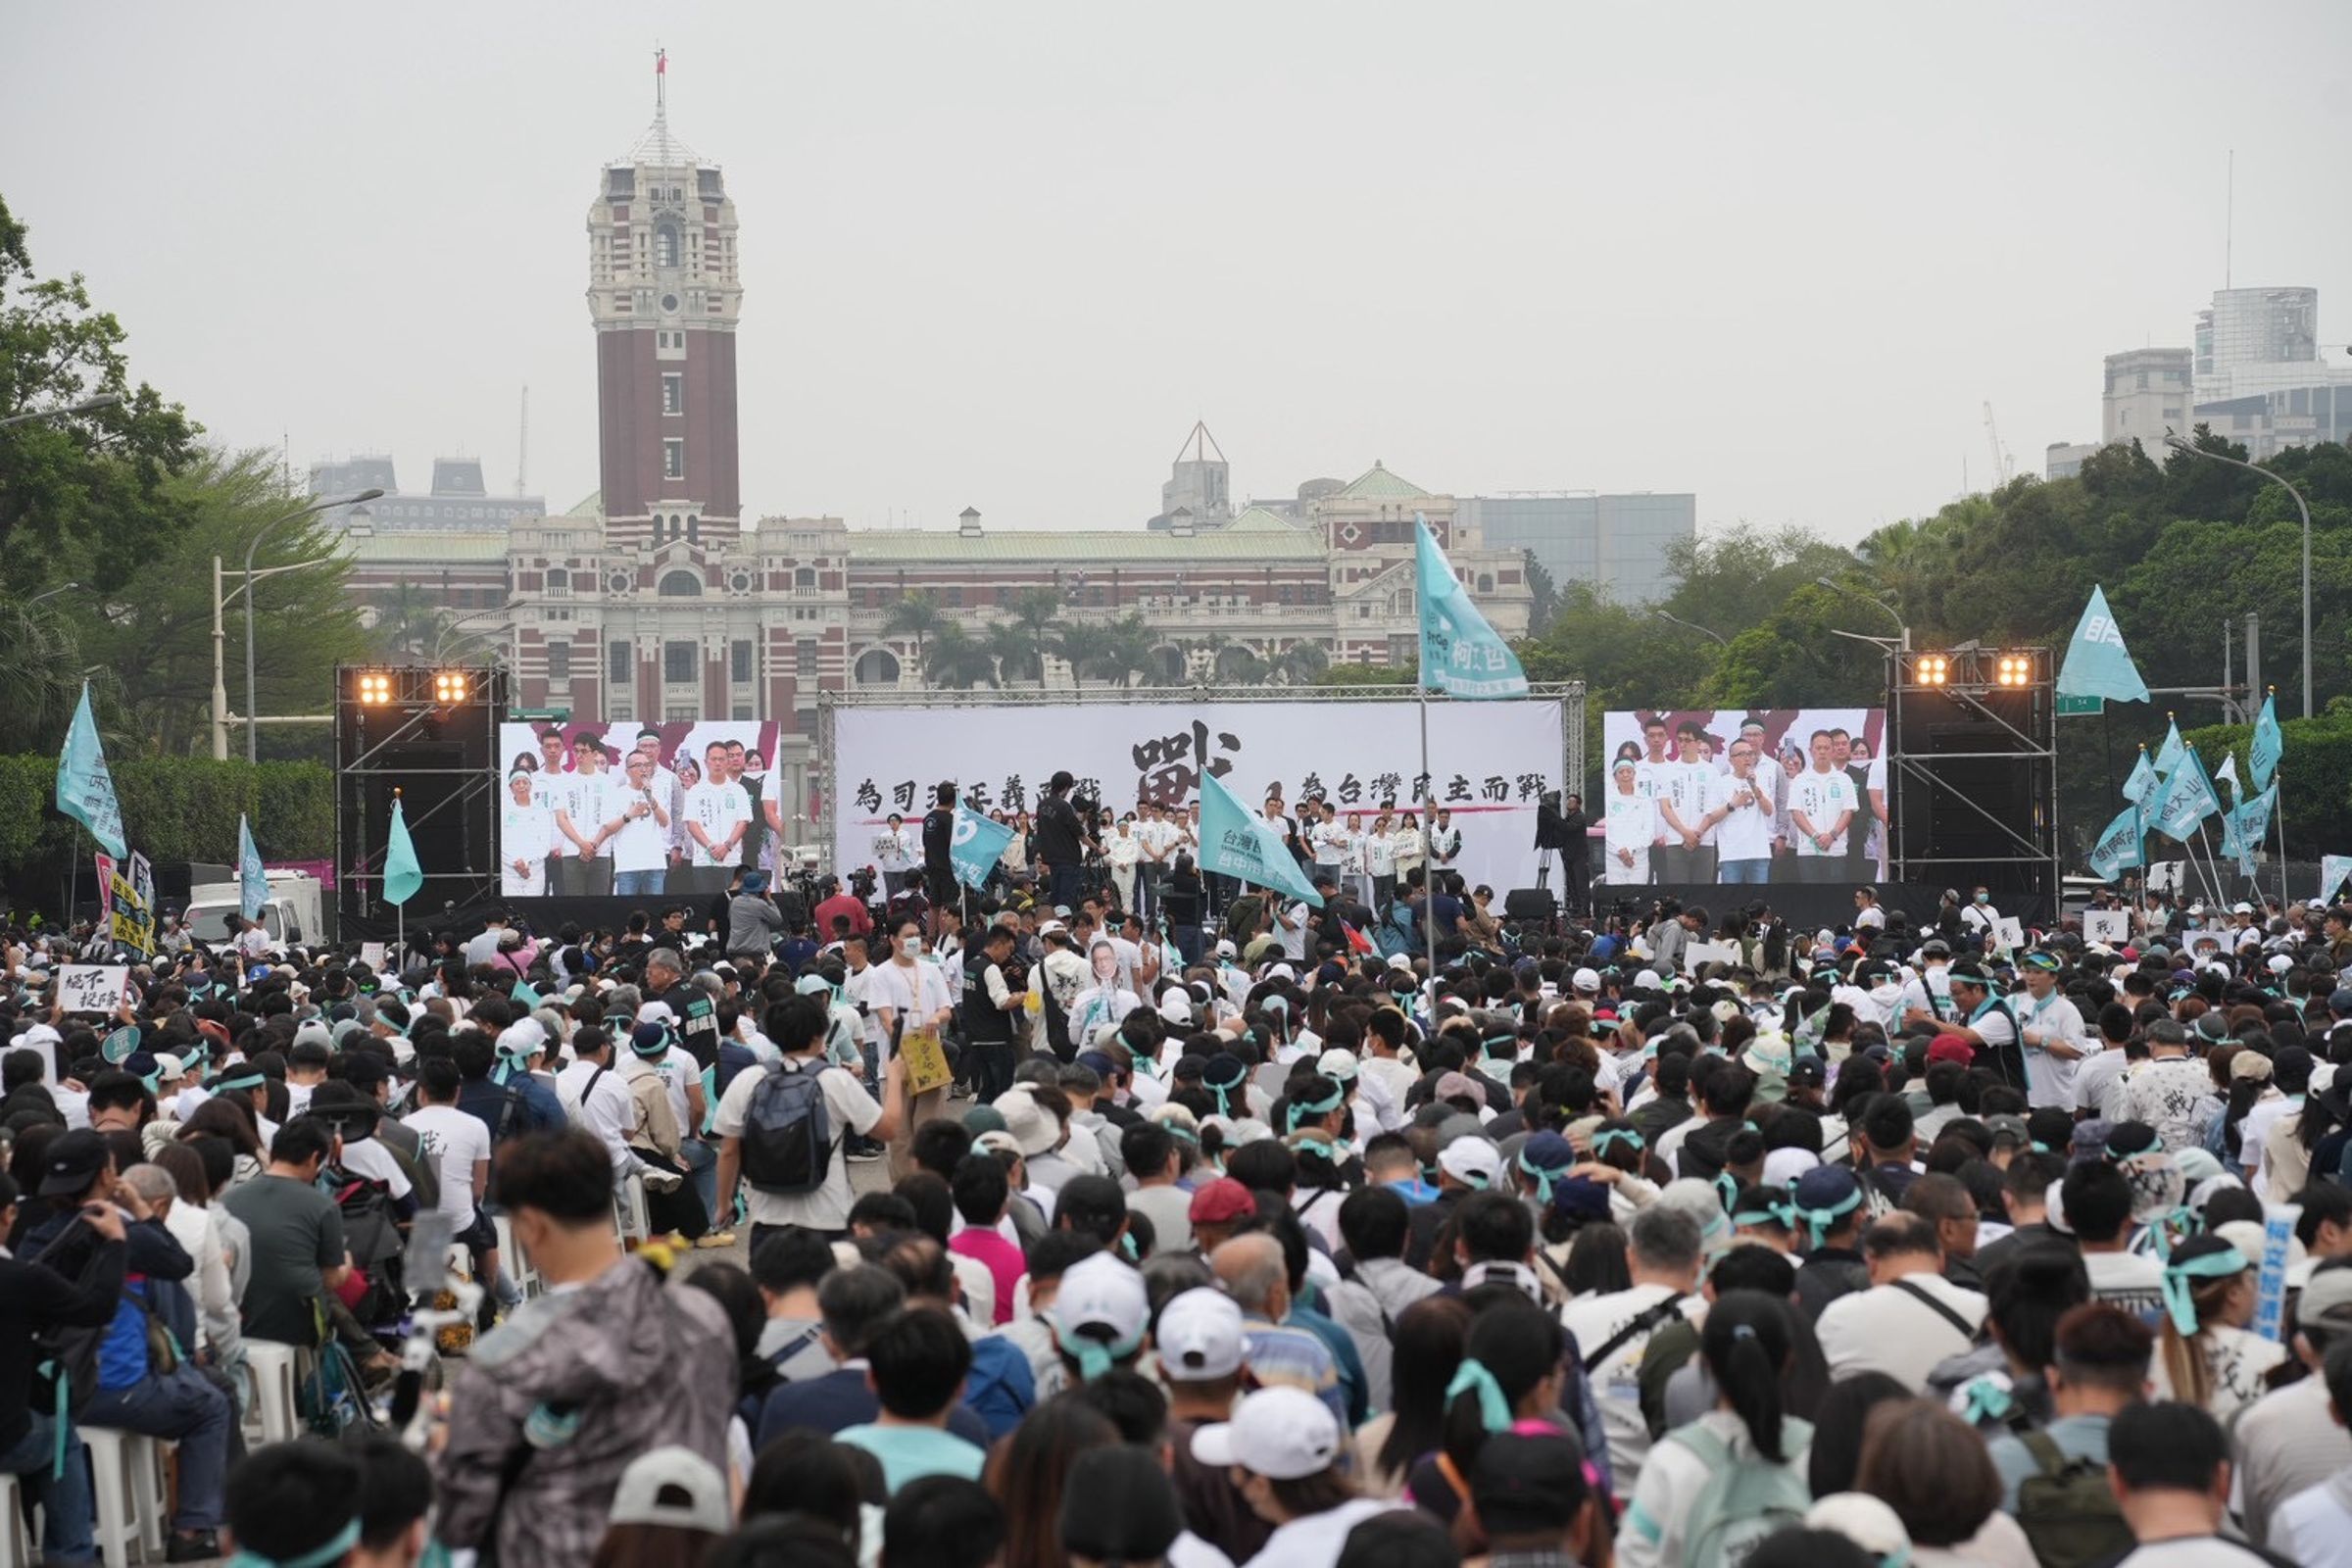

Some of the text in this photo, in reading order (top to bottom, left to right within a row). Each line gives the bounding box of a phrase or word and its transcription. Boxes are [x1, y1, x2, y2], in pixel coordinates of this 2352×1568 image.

[1299, 771, 1547, 805] 為台灣民主而戰
[65, 968, 105, 990] 絕不
[79, 990, 120, 1007] 投降
